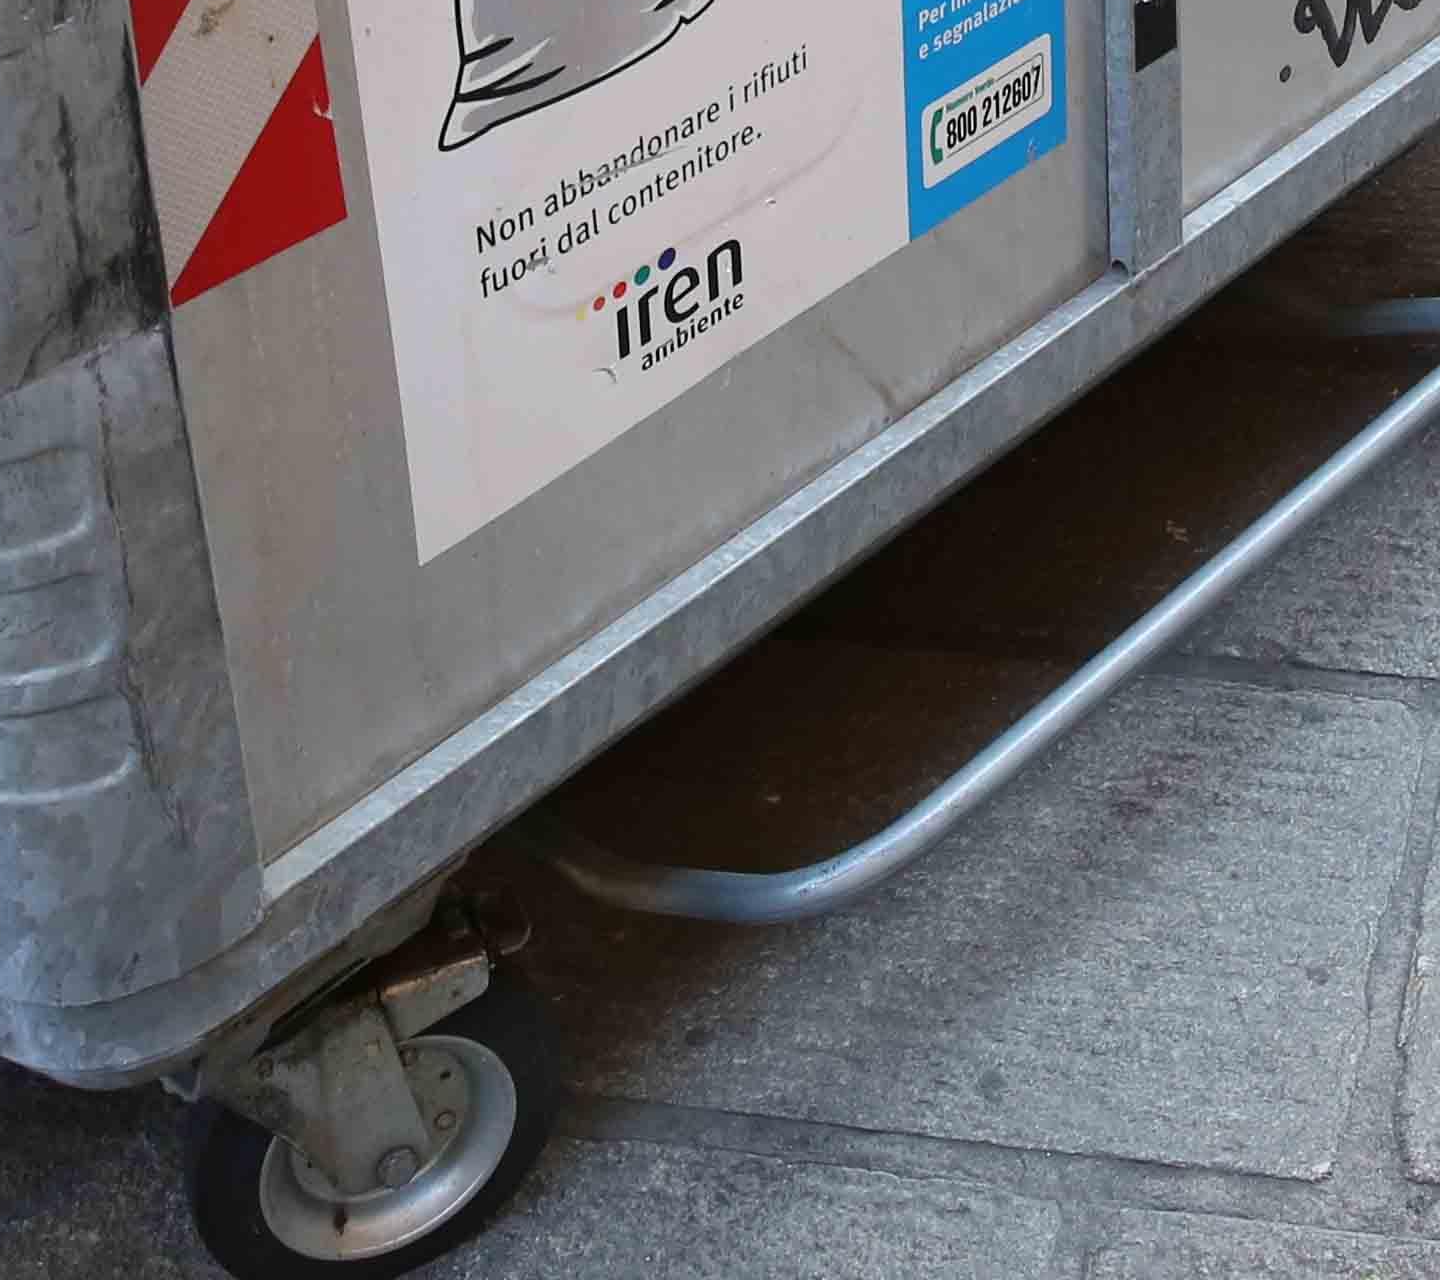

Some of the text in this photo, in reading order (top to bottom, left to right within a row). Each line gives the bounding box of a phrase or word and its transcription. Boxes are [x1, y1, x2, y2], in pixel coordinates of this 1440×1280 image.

[918, 0, 947, 33] Per
[918, 42, 930, 61] e
[474, 44, 808, 254] Non abbandonare i rifiuti
[946, 63, 1041, 150] 800 212607
[479, 123, 763, 298] fuori dal contenitore.
[615, 238, 744, 360] iren
[640, 291, 745, 372] ambiente
